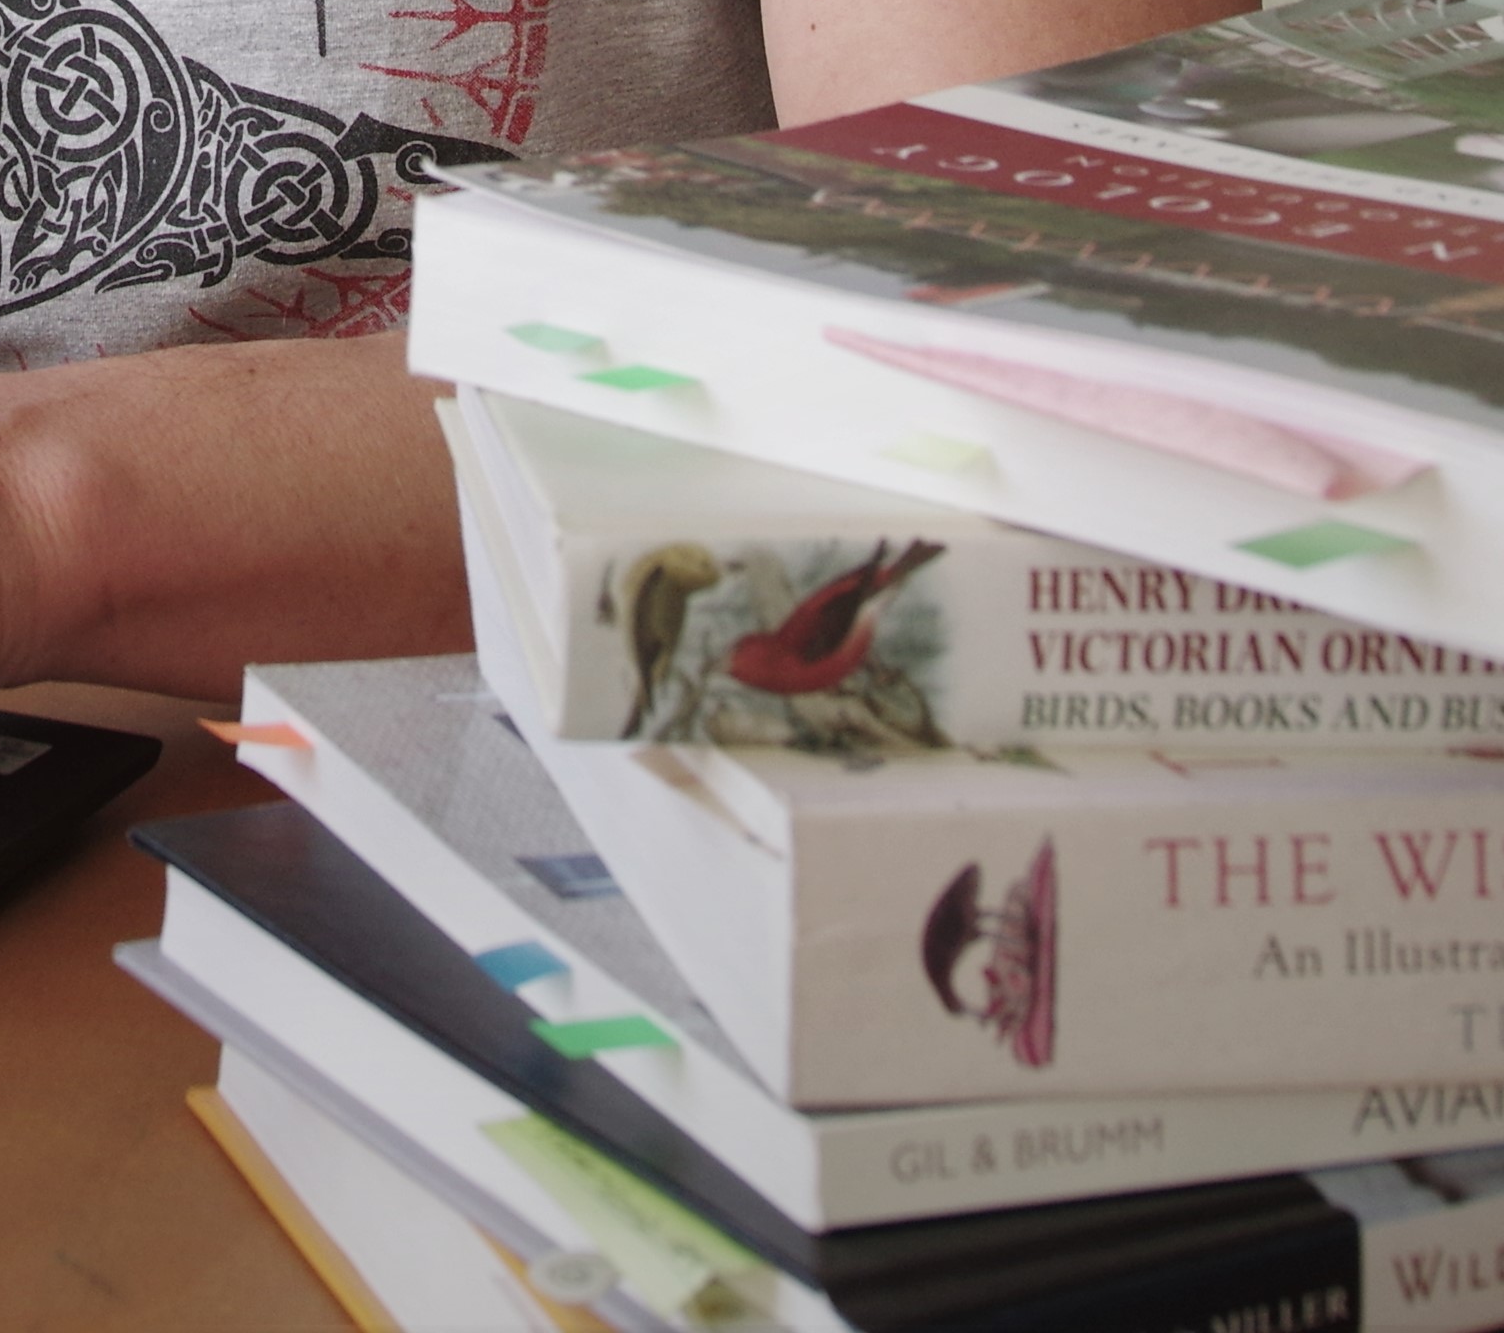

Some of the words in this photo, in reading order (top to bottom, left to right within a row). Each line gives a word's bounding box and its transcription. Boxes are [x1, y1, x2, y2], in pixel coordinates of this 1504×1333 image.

[872, 142, 1355, 239] ECOLOGY
[1028, 567, 1197, 614] HENRY
[1028, 630, 1308, 675] VICTORIAN
[1020, 692, 1161, 735] BIRDS,
[1172, 694, 1323, 733] BOOKS
[1335, 694, 1430, 733] AND
[1142, 833, 1339, 910] THE
[1252, 933, 1325, 981] An
[890, 1139, 955, 1185] GIL
[968, 1136, 1000, 1174] &
[1011, 1116, 1166, 1171] BRUMM
